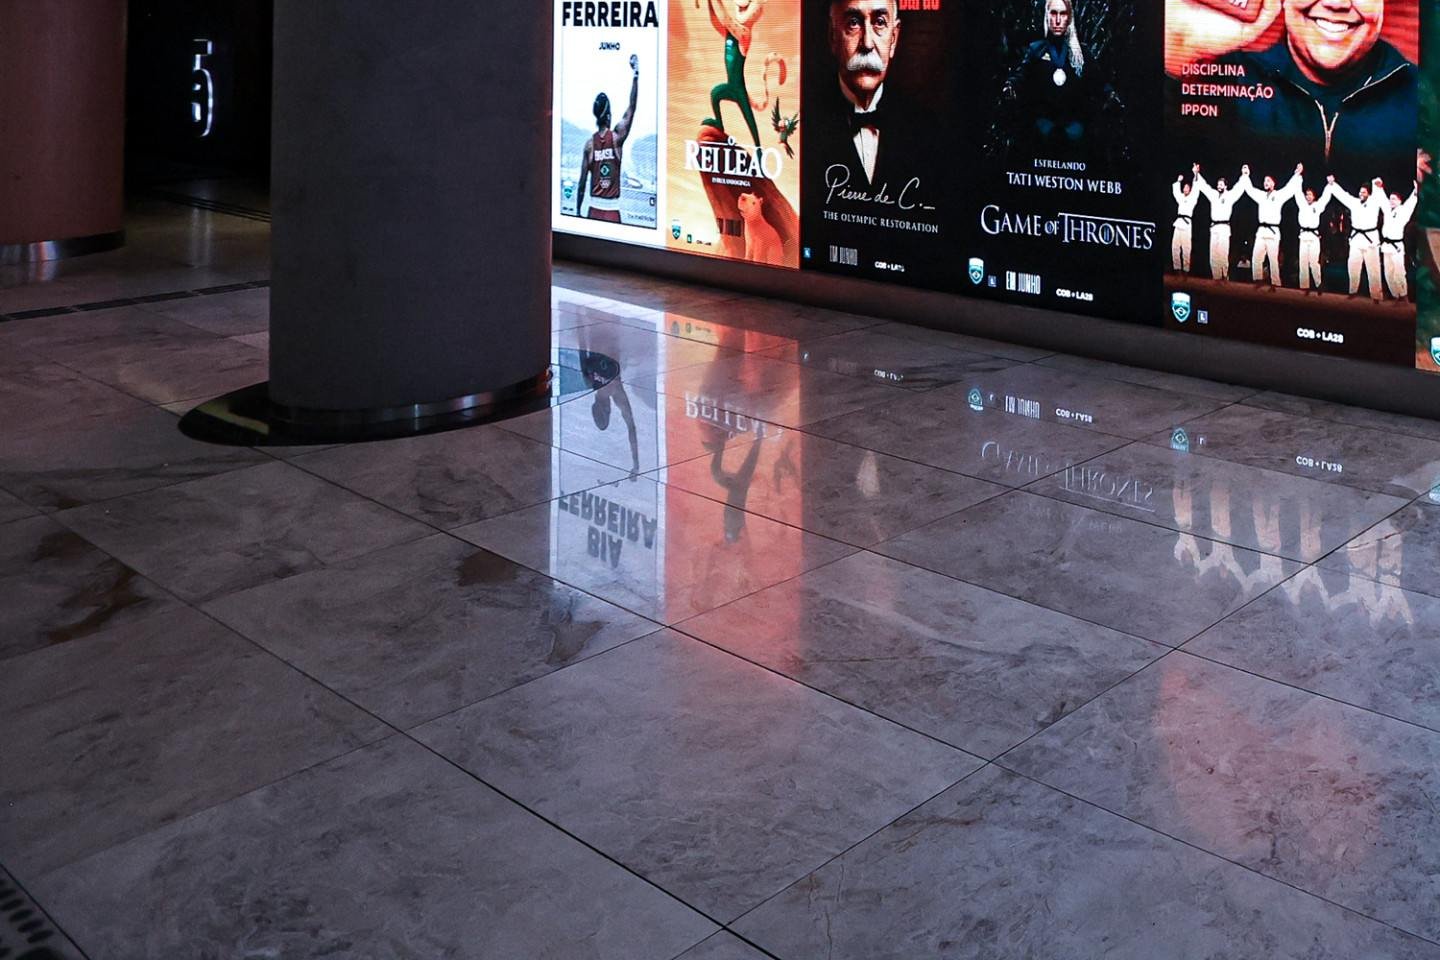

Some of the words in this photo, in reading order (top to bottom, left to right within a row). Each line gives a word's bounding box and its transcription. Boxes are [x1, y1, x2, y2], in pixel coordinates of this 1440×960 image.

[562, 1, 659, 28] FERREIRA
[1182, 64, 1245, 77] DISCIPLINA
[1182, 82, 1274, 100] DETERMINAÇÃO
[1181, 104, 1218, 118] IPPON
[685, 140, 720, 174] REI
[1034, 158, 1086, 171] ESTRELANDO
[1006, 171, 1032, 187] TATI
[1034, 175, 1084, 191] WESTON
[1087, 180, 1122, 195] WEBB
[823, 210, 839, 221] THE
[841, 213, 877, 226] OLYMPIC
[880, 218, 939, 233] RESTORATION
[980, 204, 1042, 237] GAME
[1058, 212, 1155, 250] THRONES
